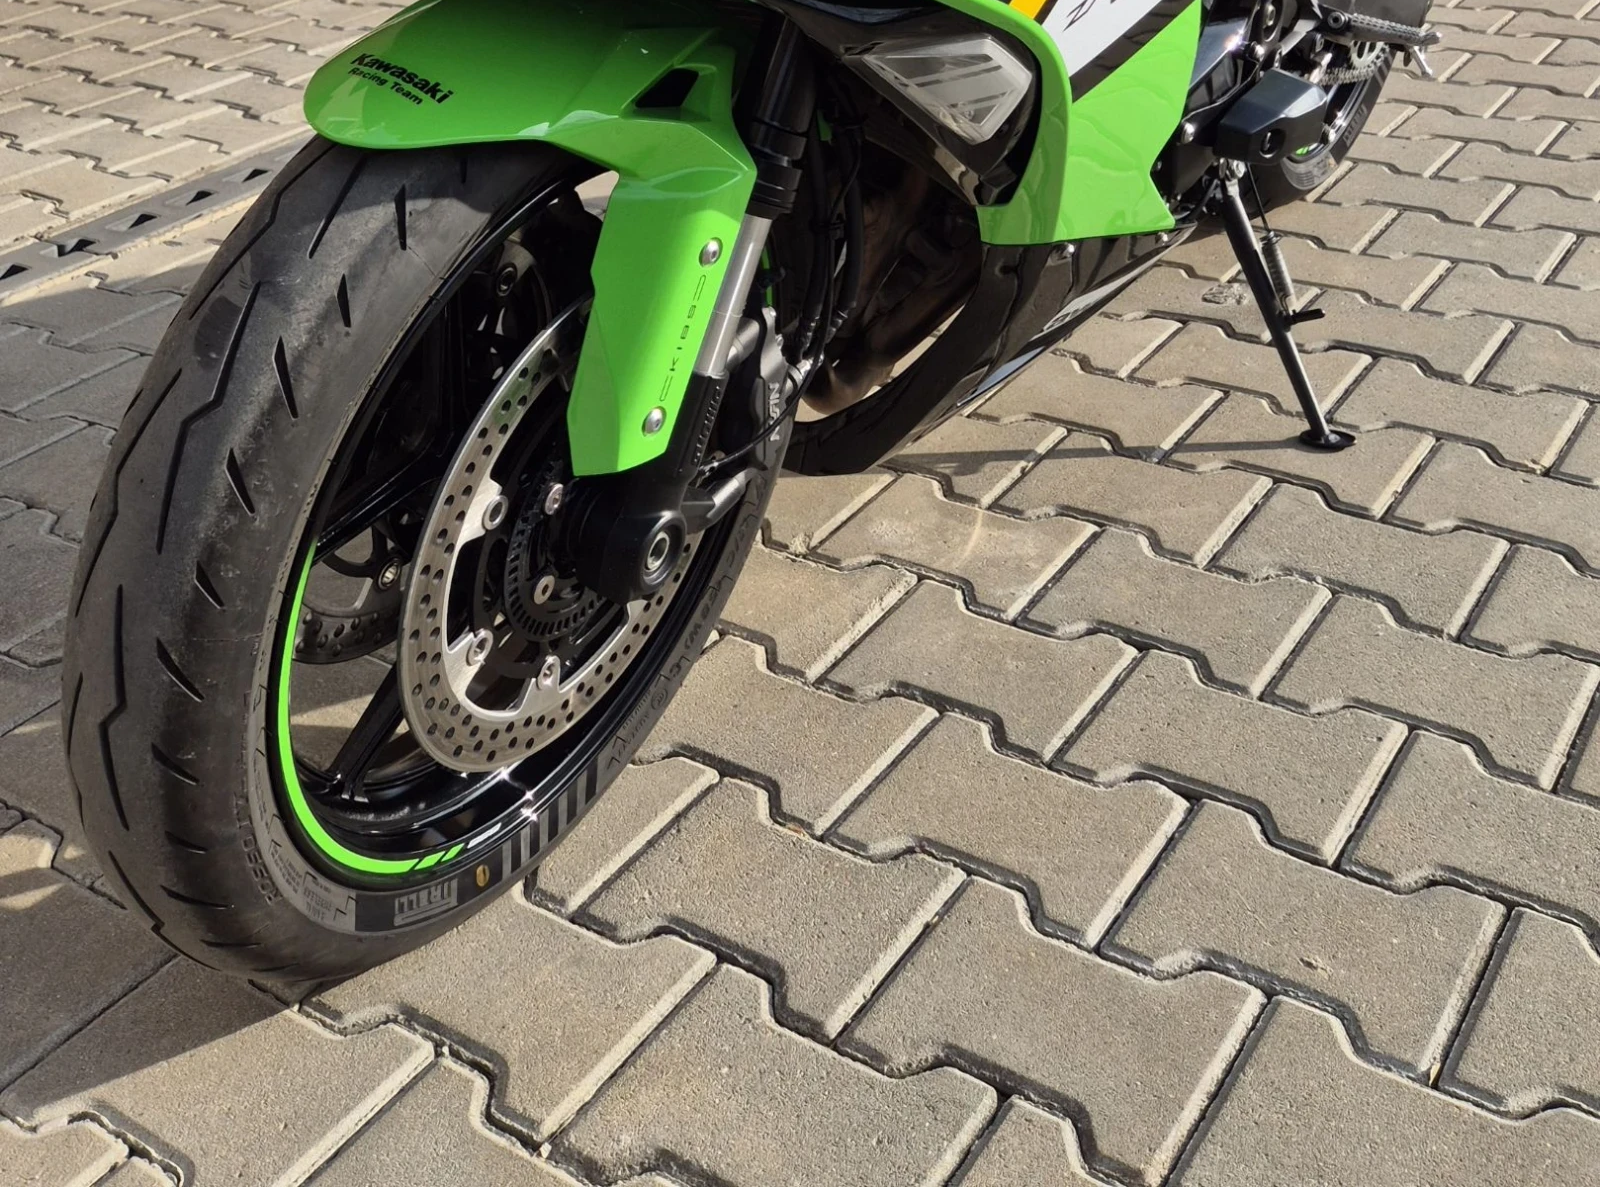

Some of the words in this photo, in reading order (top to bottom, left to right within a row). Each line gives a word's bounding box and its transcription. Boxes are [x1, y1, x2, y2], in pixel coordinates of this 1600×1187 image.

[347, 67, 388, 86] Racing
[390, 81, 423, 105] Team
[350, 53, 454, 104] Kawasaki
[769, 382, 780, 442] NSSIN
